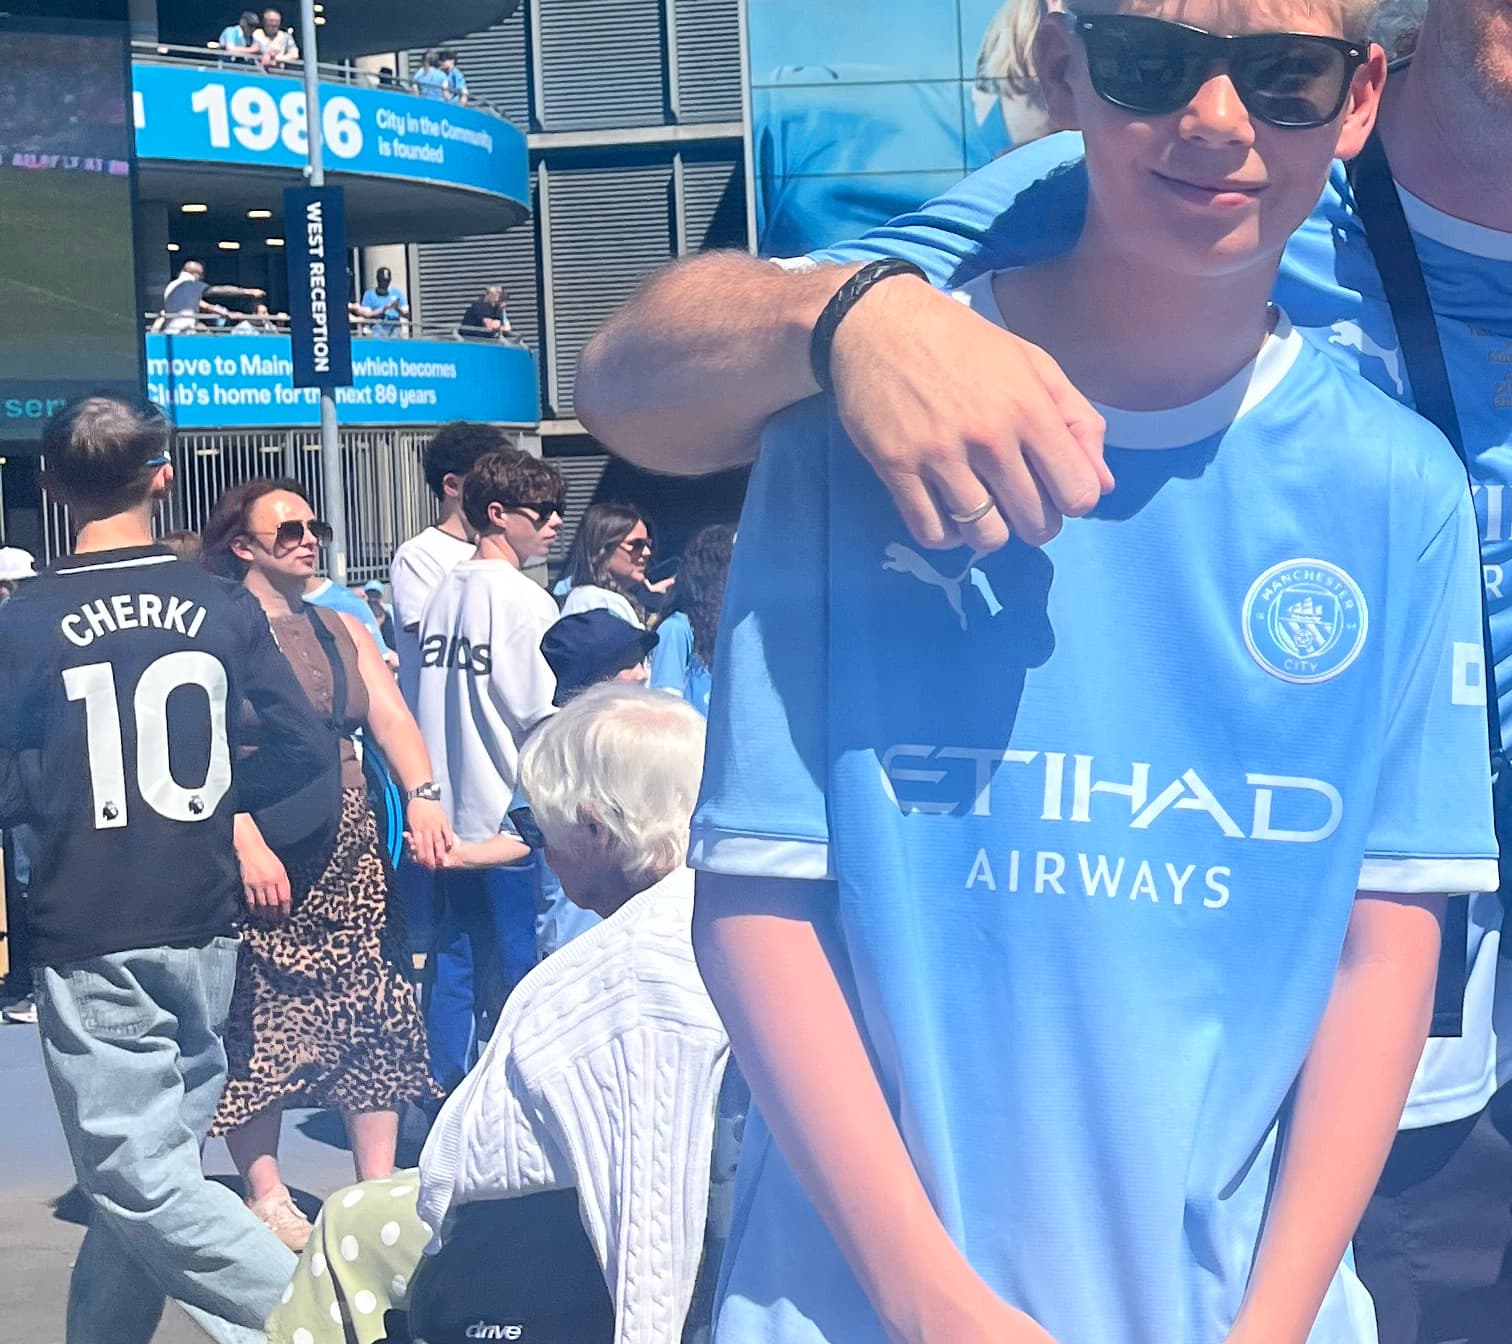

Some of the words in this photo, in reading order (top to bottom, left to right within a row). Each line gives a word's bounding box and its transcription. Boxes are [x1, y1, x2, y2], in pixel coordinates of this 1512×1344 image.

[191, 83, 364, 160] 1986
[376, 108, 406, 137] City
[406, 113, 418, 134] in
[418, 115, 442, 137] the
[441, 119, 494, 154] Community
[378, 136, 392, 155] is
[393, 140, 445, 164] founded
[306, 201, 324, 258] WEST
[309, 262, 330, 373] RECEPTION
[147, 355, 212, 377] move
[215, 355, 238, 377] to
[241, 354, 295, 377] Main
[352, 355, 399, 378] which
[400, 358, 457, 380] becomes
[214, 383, 271, 406] home
[274, 385, 300, 405] for
[335, 385, 373, 405] next
[400, 387, 437, 409] years
[1261, 568, 1355, 610] MANCHESTER
[60, 594, 207, 648] CHERKI
[1283, 658, 1318, 673] CITY
[62, 650, 233, 830] 10
[882, 743, 1345, 844] ETIHAD
[964, 847, 1232, 910] AIRWAYS
[465, 1320, 523, 1341] drive
